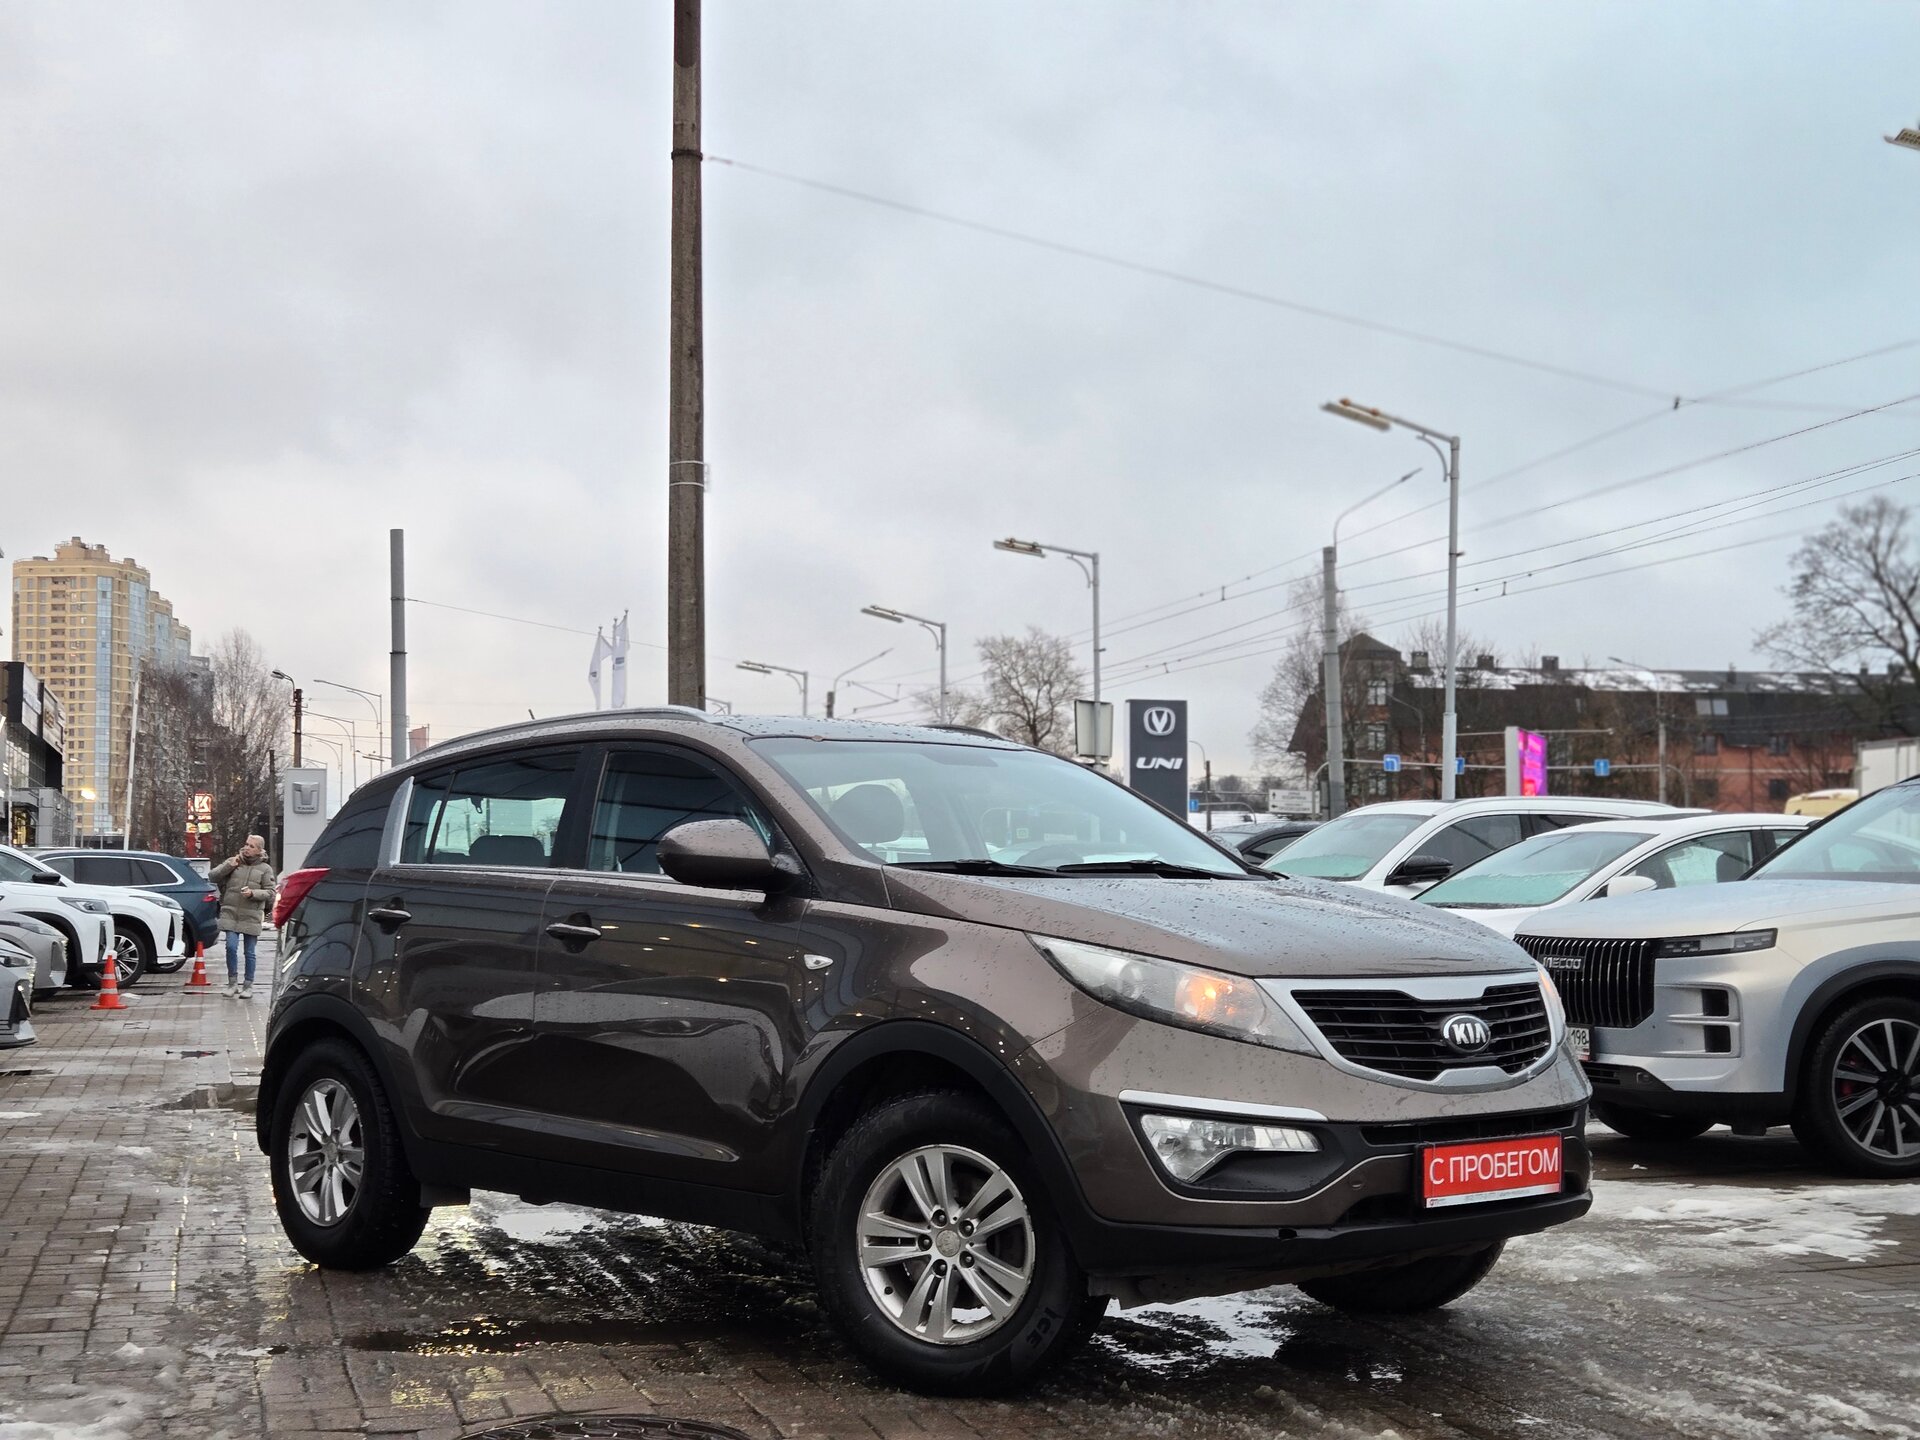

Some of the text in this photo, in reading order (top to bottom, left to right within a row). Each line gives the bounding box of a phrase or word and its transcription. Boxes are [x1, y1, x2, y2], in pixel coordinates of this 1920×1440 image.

[1136, 757, 1183, 769] UNI
[1451, 1022, 1487, 1045] KIA
[1571, 1029, 1588, 1045] 198
[1429, 1147, 1559, 1185] С ПРОБЕГОМ
[1026, 1306, 1065, 1349] ICE
